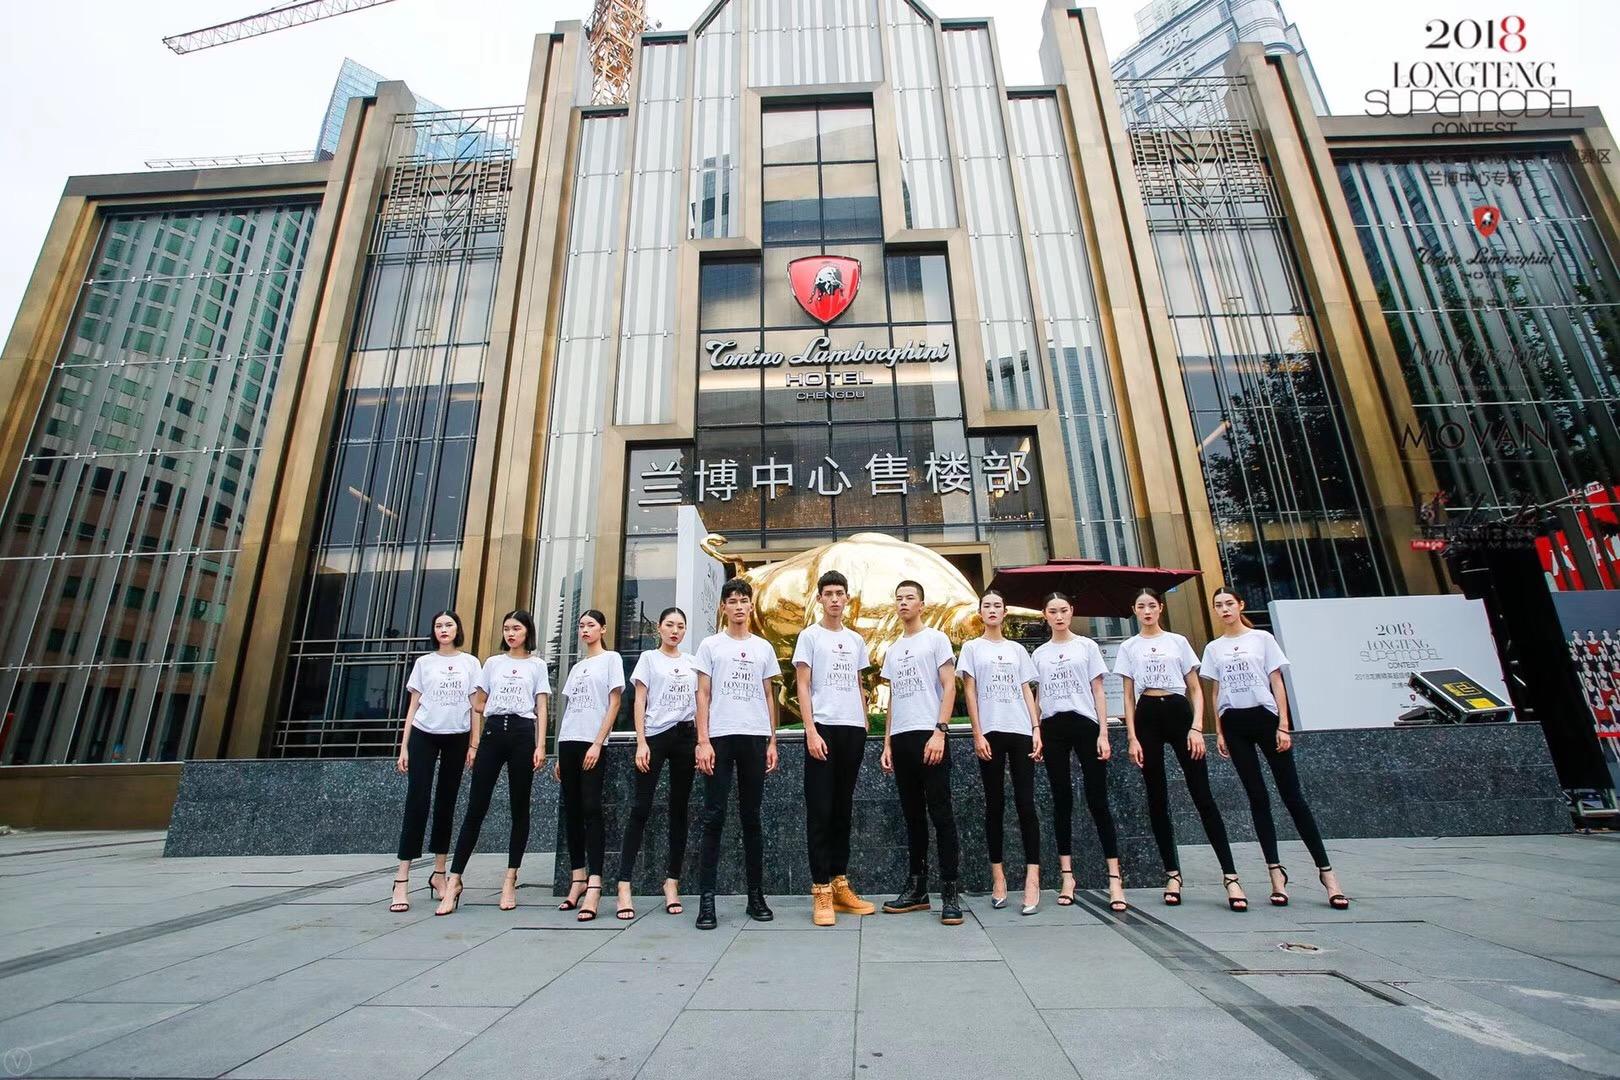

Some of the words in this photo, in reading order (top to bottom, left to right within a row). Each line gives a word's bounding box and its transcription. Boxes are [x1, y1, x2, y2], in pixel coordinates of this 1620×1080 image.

[705, 339, 784, 370] Tonino
[788, 336, 951, 369] Lamborghini
[785, 371, 874, 388] HOTEL
[796, 389, 866, 400] CHENGDU
[637, 450, 1033, 508] 兰博中心售楼部
[1375, 622, 1414, 636] 2018
[1225, 661, 1249, 673] 2018
[1387, 661, 1419, 669] CONTEST
[732, 671, 754, 681] 2018
[1050, 670, 1073, 681] 2018
